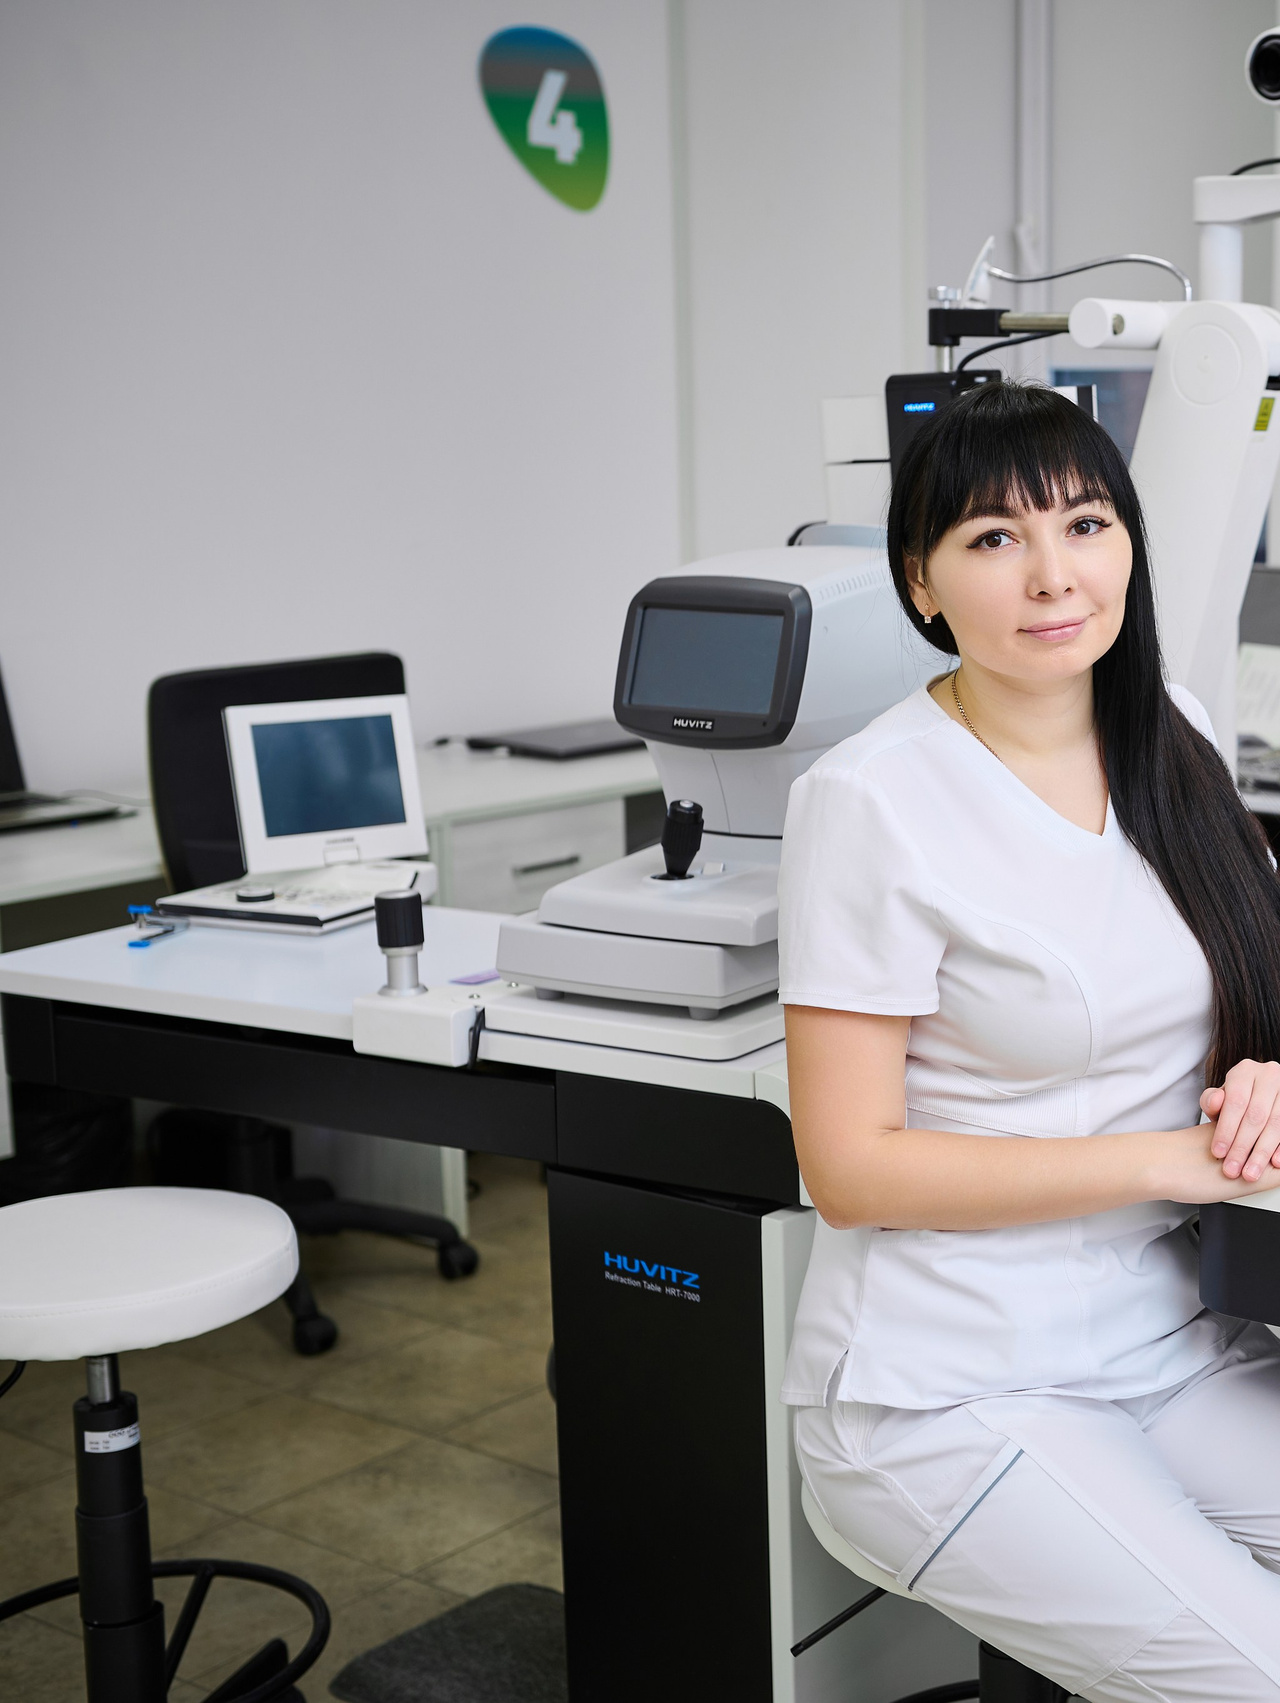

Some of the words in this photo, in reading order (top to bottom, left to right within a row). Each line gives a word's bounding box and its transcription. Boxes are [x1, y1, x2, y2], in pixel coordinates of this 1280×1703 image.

[528, 69, 582, 165] 4
[673, 718, 713, 729] HUVITZ
[604, 1251, 700, 1289] HUVITZ
[604, 1270, 641, 1288] Refraction
[642, 1280, 662, 1293] Table
[665, 1286, 700, 1303] HRT-7000
